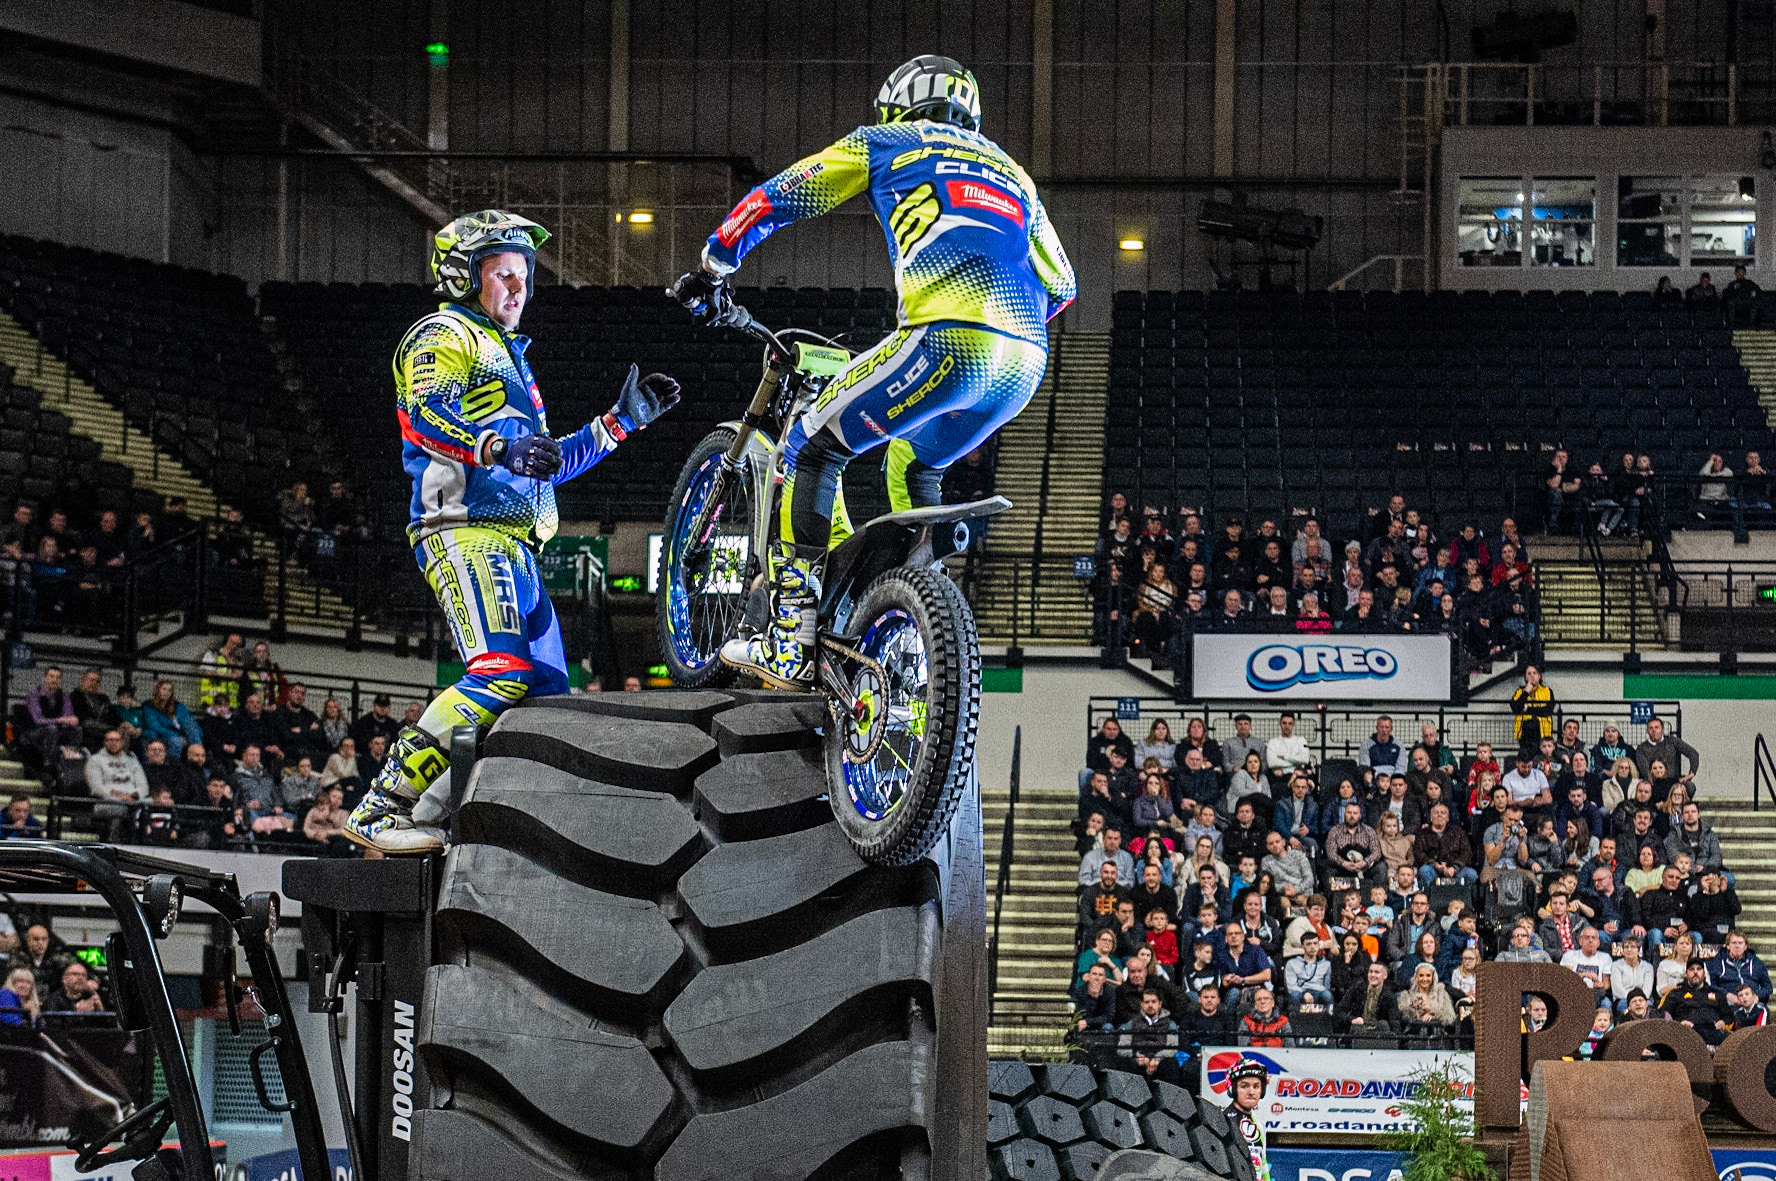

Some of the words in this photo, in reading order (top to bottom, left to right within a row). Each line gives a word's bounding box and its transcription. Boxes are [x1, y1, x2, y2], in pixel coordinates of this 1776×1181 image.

[960, 184, 1019, 214] Milwaukee
[885, 354, 930, 399] CLICE
[886, 354, 955, 421] SHERCO
[485, 552, 521, 634] MRS
[1249, 644, 1397, 690] OREO
[391, 1000, 414, 1142] DOOSAN
